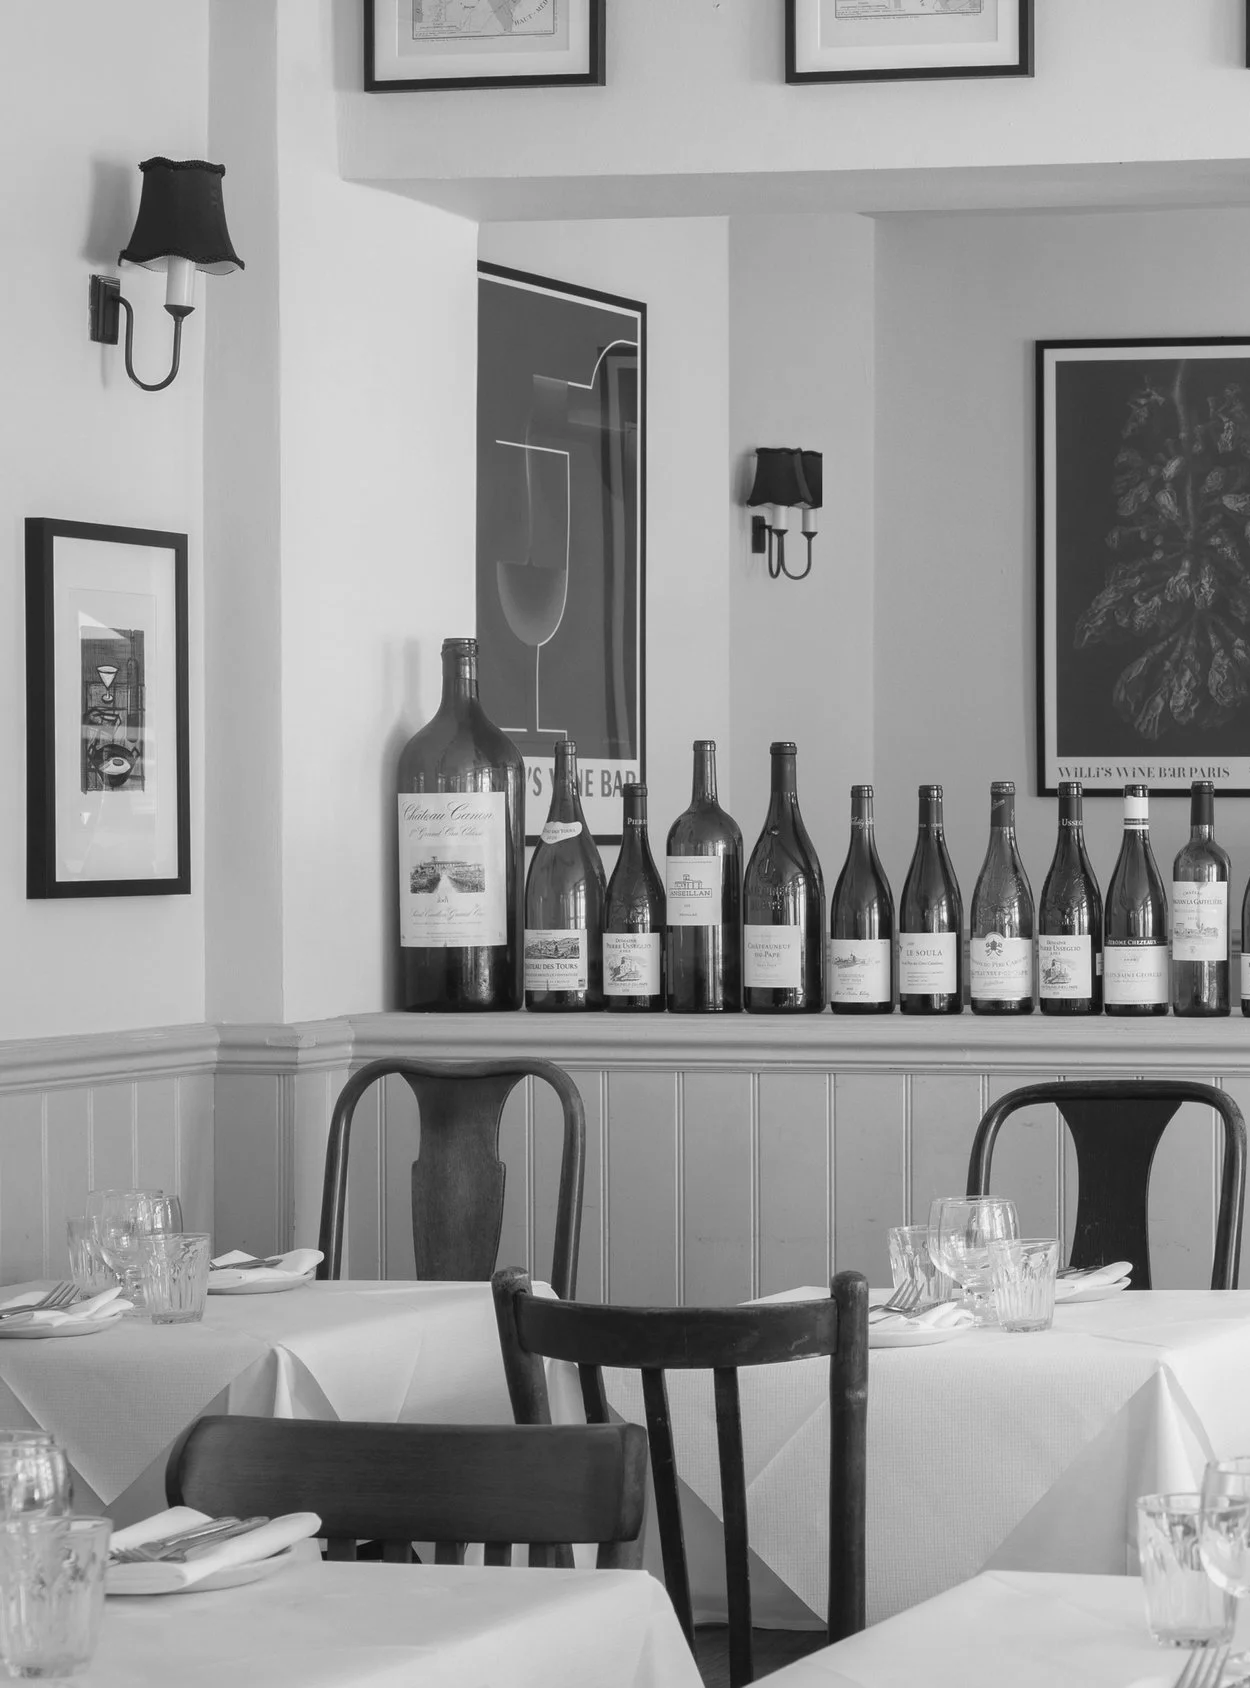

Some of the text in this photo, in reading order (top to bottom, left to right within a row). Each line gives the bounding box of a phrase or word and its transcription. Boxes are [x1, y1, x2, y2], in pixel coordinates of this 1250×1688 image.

[1189, 767, 1230, 778] PARIS
[402, 800, 494, 821] Château Canon
[915, 949, 942, 957] SOULA
[556, 962, 578, 970] TOURS
